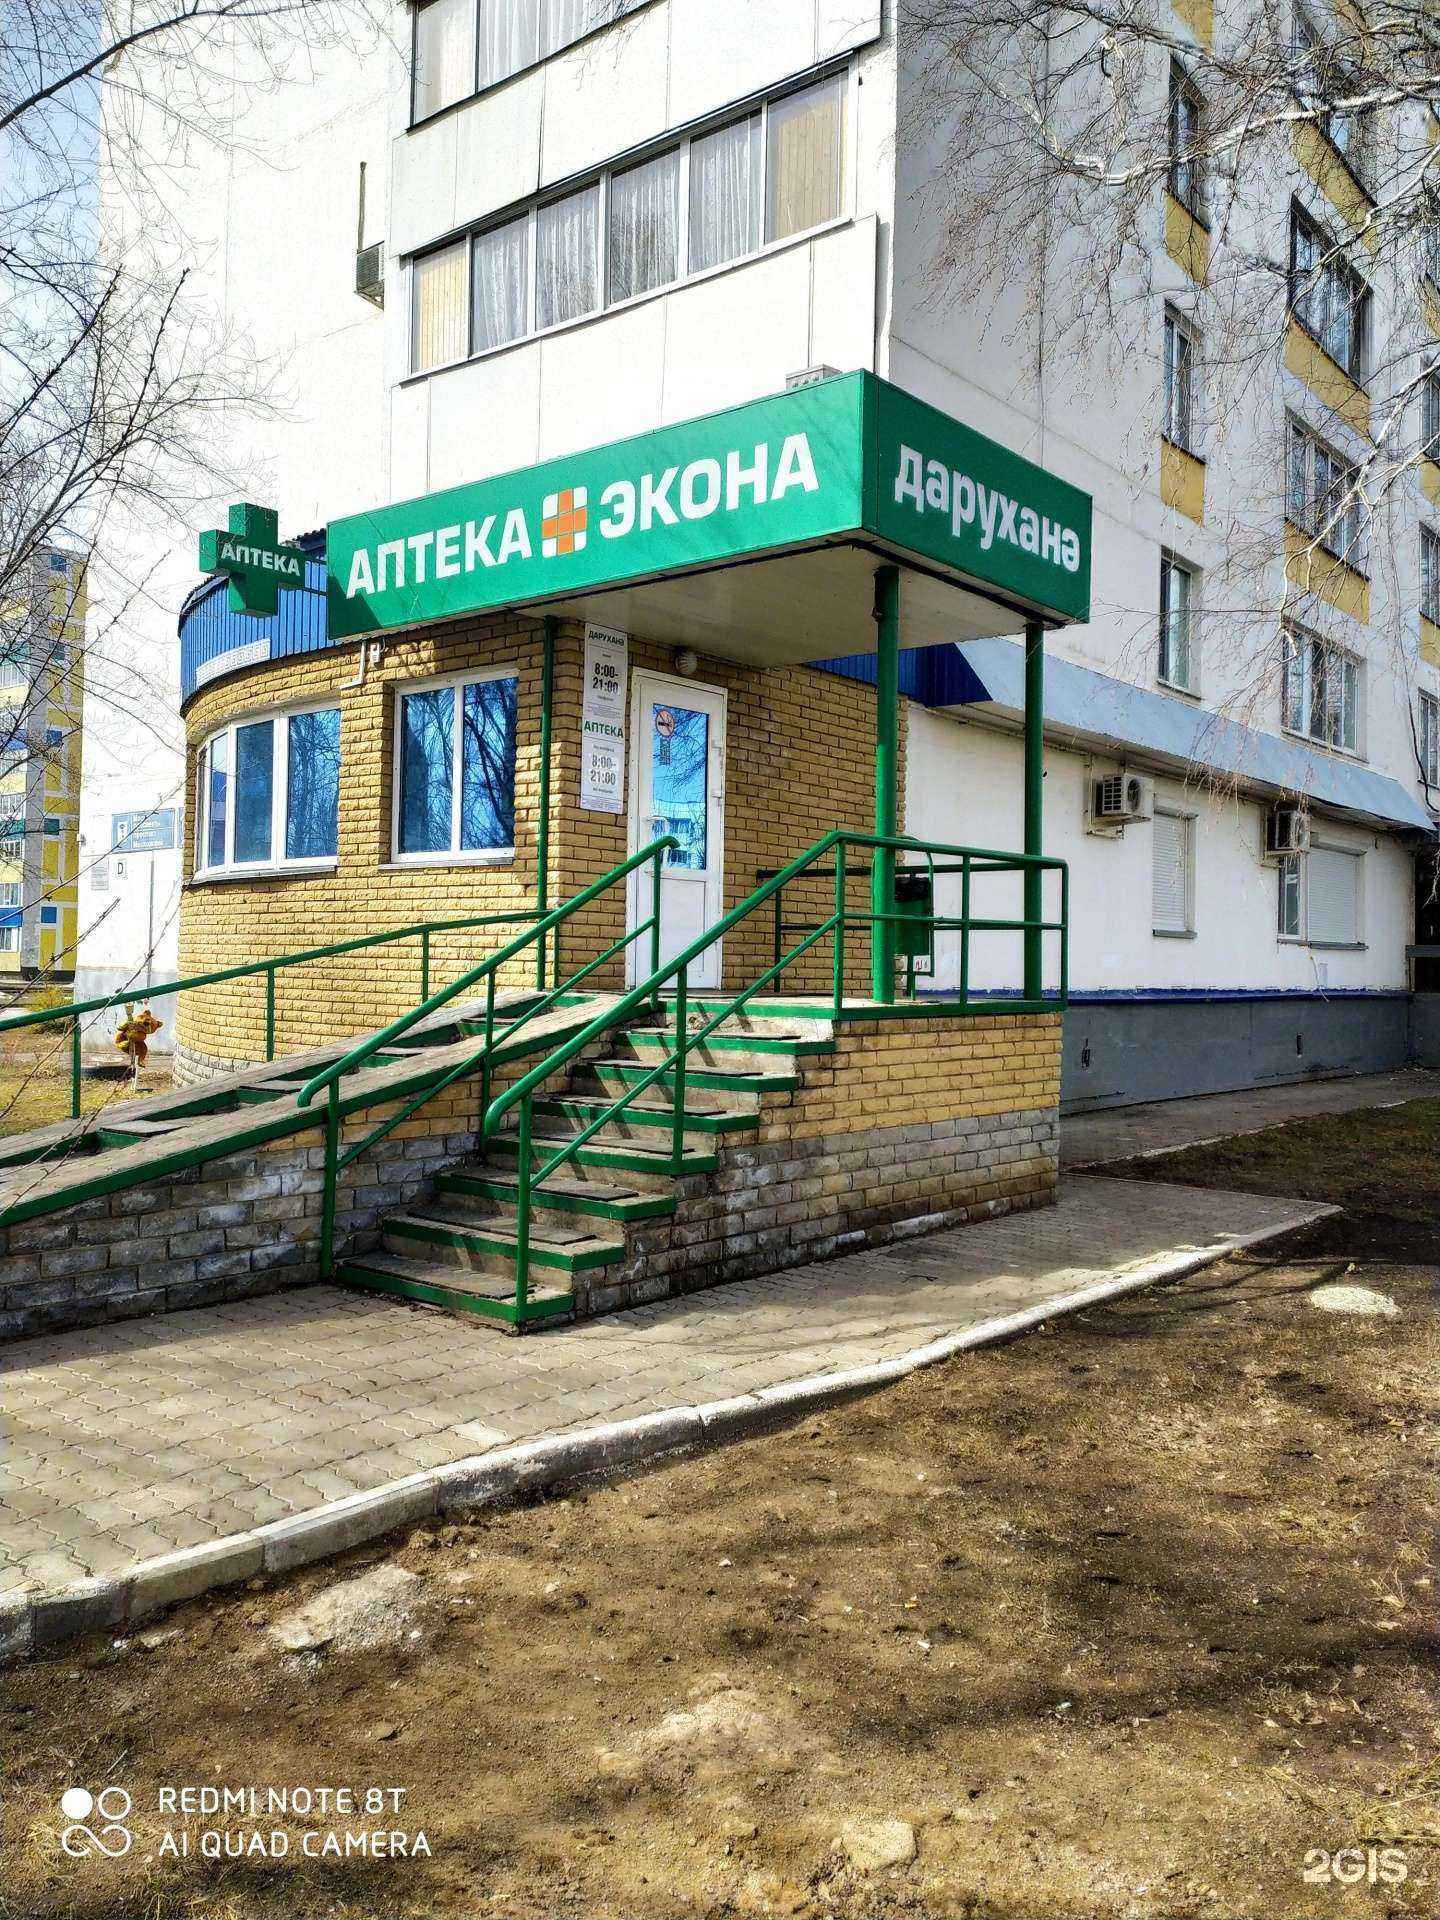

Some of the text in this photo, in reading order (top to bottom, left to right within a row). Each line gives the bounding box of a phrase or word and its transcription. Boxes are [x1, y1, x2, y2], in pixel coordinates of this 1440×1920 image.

[346, 432, 820, 600] АПТЕКА ЭКОНА
[895, 443, 1081, 573] даруханә
[220, 542, 301, 577] АПТЕКА
[594, 662, 619, 679] 8:00-
[592, 677, 619, 696] 21:00
[583, 720, 624, 739] АПТЕКА
[591, 754, 617, 769] 8:00-
[590, 769, 616, 786] 21:00
